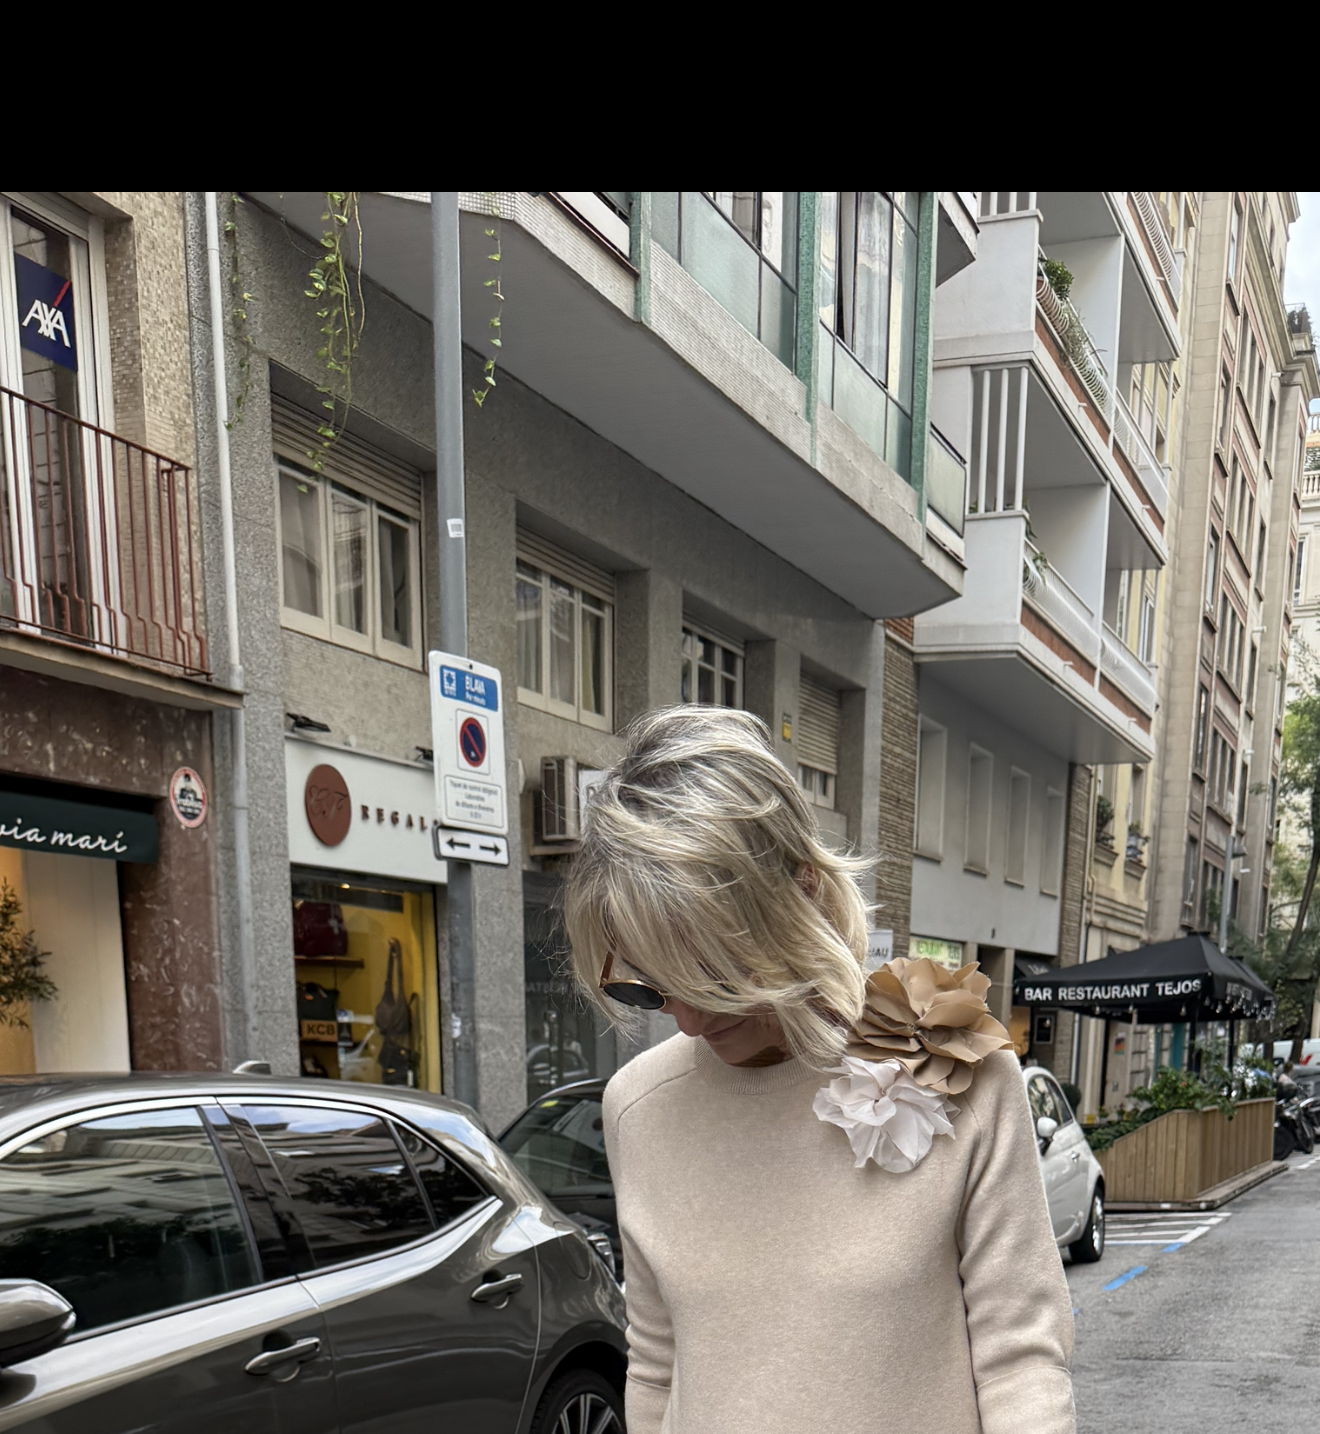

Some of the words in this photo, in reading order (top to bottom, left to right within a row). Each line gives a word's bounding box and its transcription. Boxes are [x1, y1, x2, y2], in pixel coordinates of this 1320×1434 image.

[21, 299, 71, 348] AXA
[50, 831, 127, 853] marí
[1024, 986, 1052, 1001] BAR
[1058, 983, 1149, 1000] RESTAURANT
[1155, 979, 1201, 996] TEJOS
